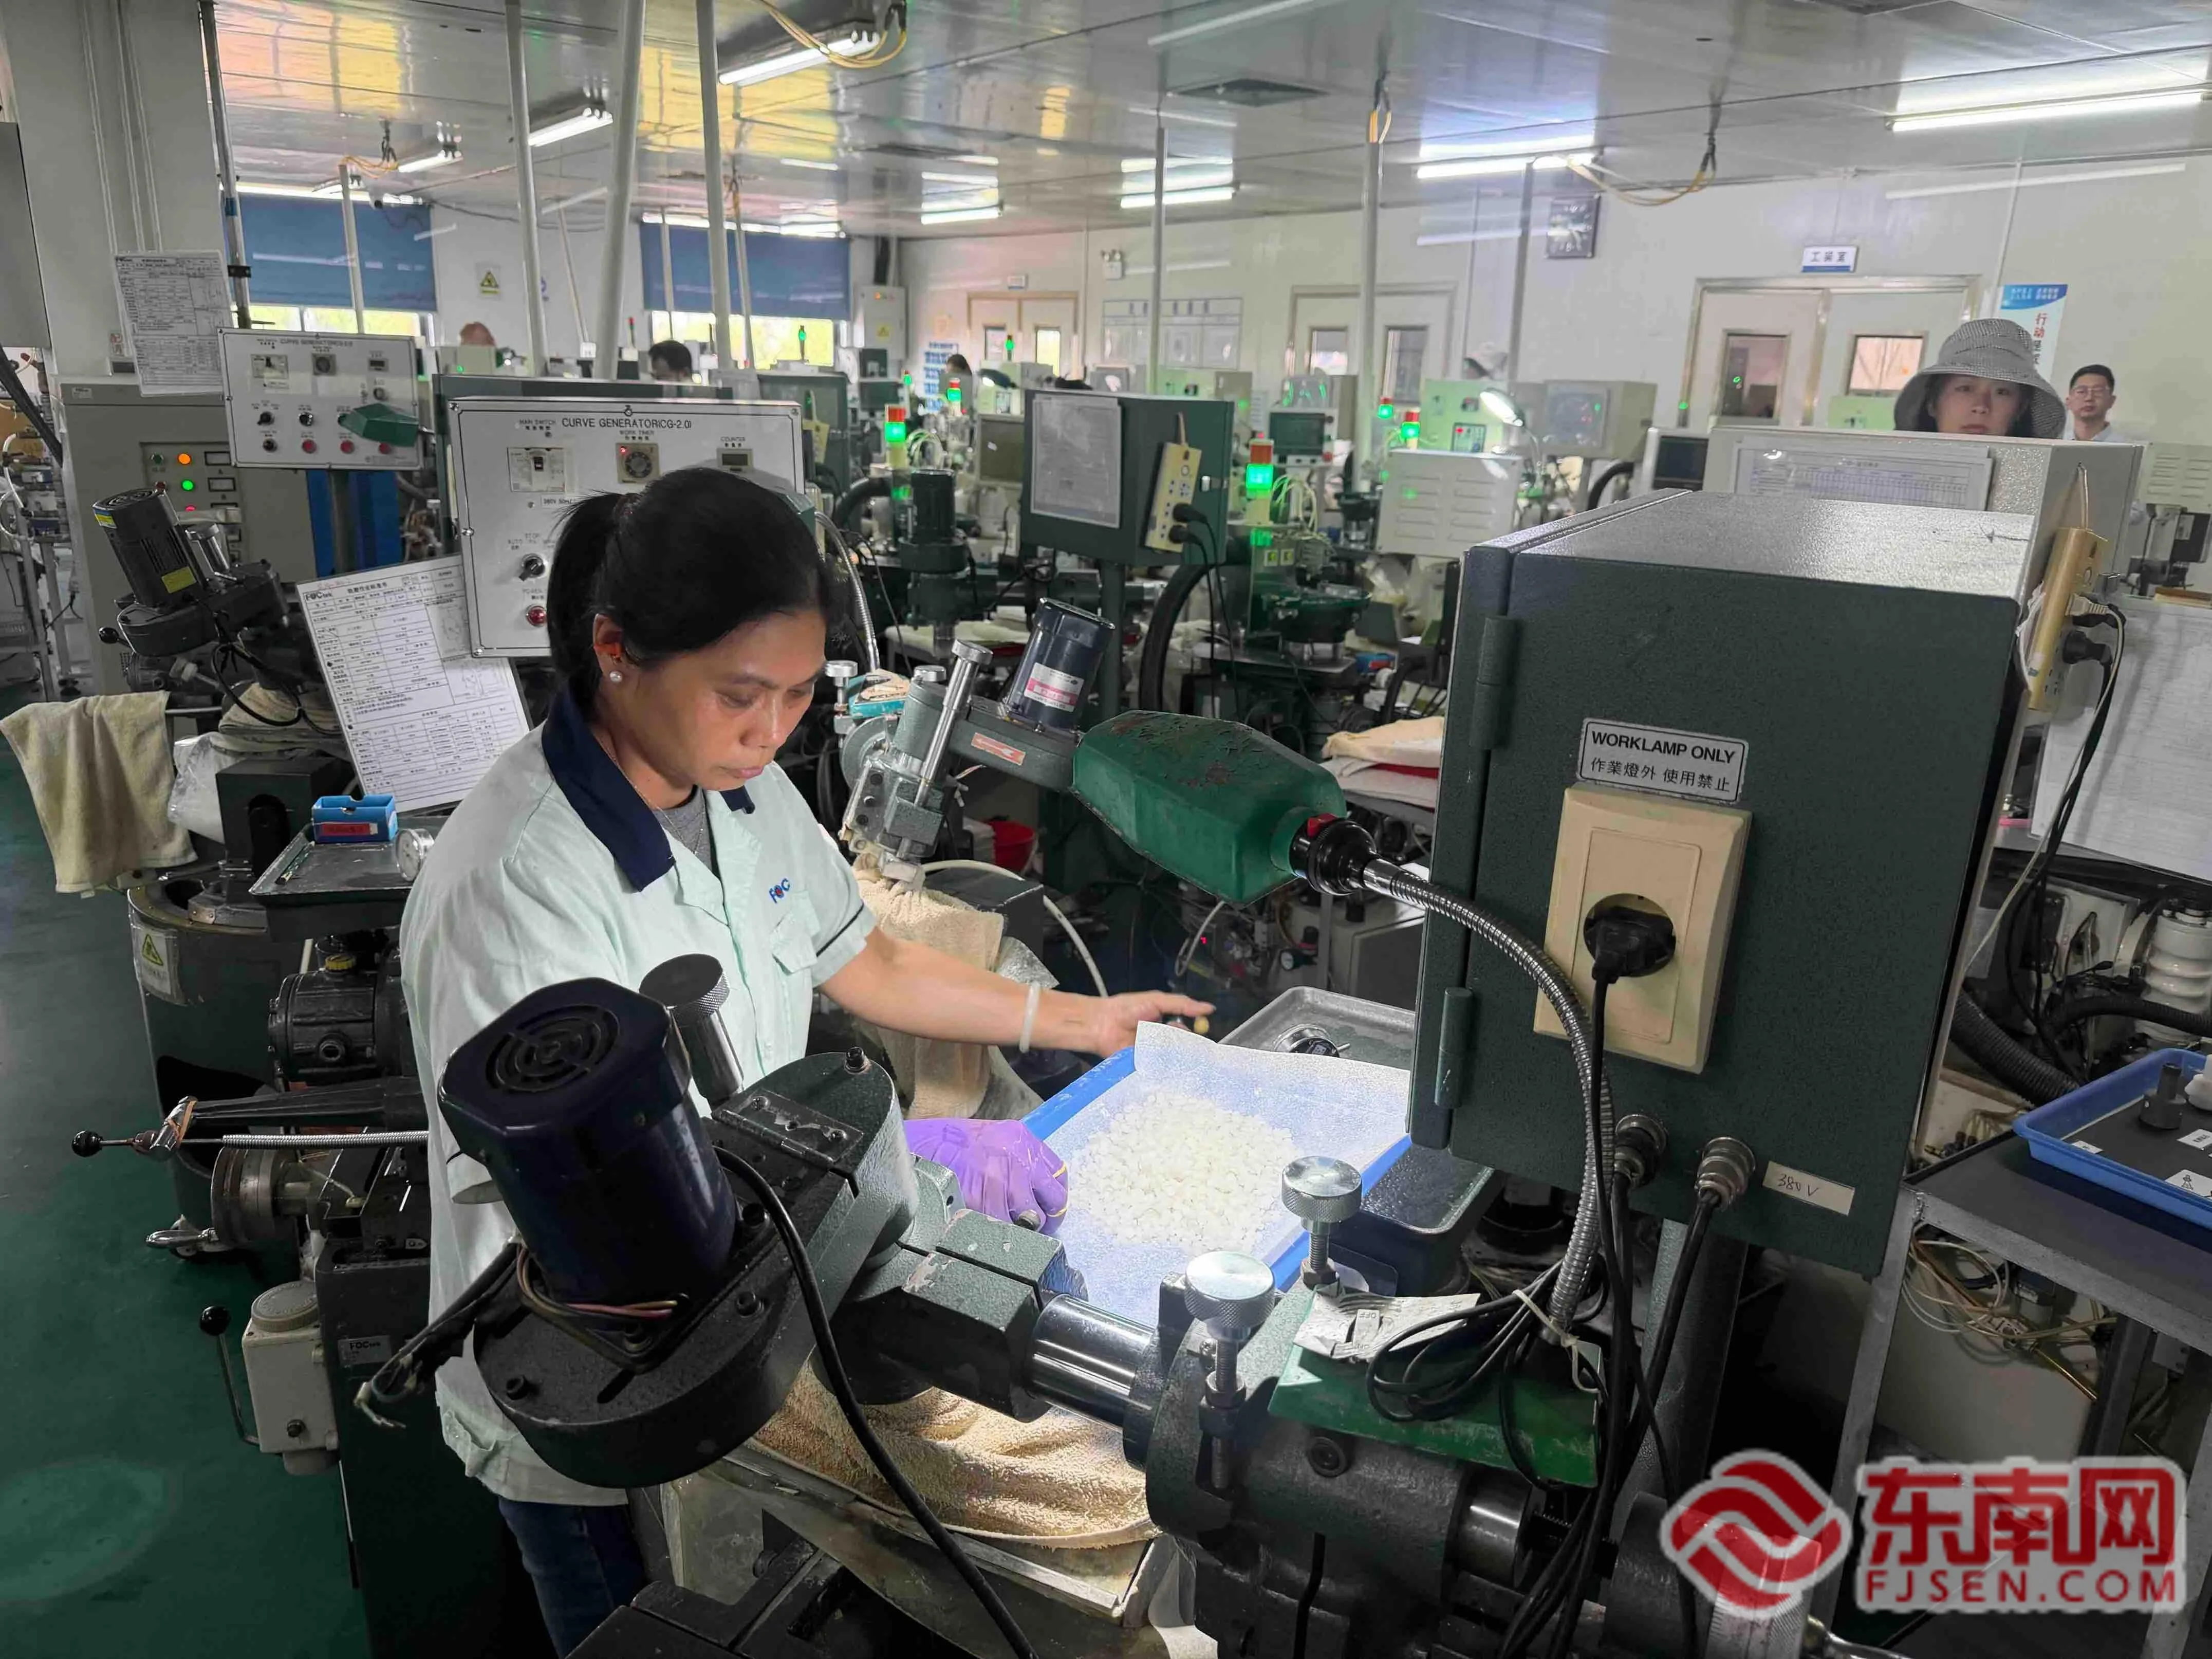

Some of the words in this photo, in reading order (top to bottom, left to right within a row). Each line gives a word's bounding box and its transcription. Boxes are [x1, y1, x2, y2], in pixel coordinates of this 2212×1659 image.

[562, 418, 596, 428] CURVE
[1591, 730, 1687, 756] WORKLAMP
[1691, 745, 1736, 764] ONLY
[1591, 757, 1657, 781] 作業燈外
[1663, 768, 1730, 792] 使用禁止
[1359, 1311, 1377, 1319] OFF
